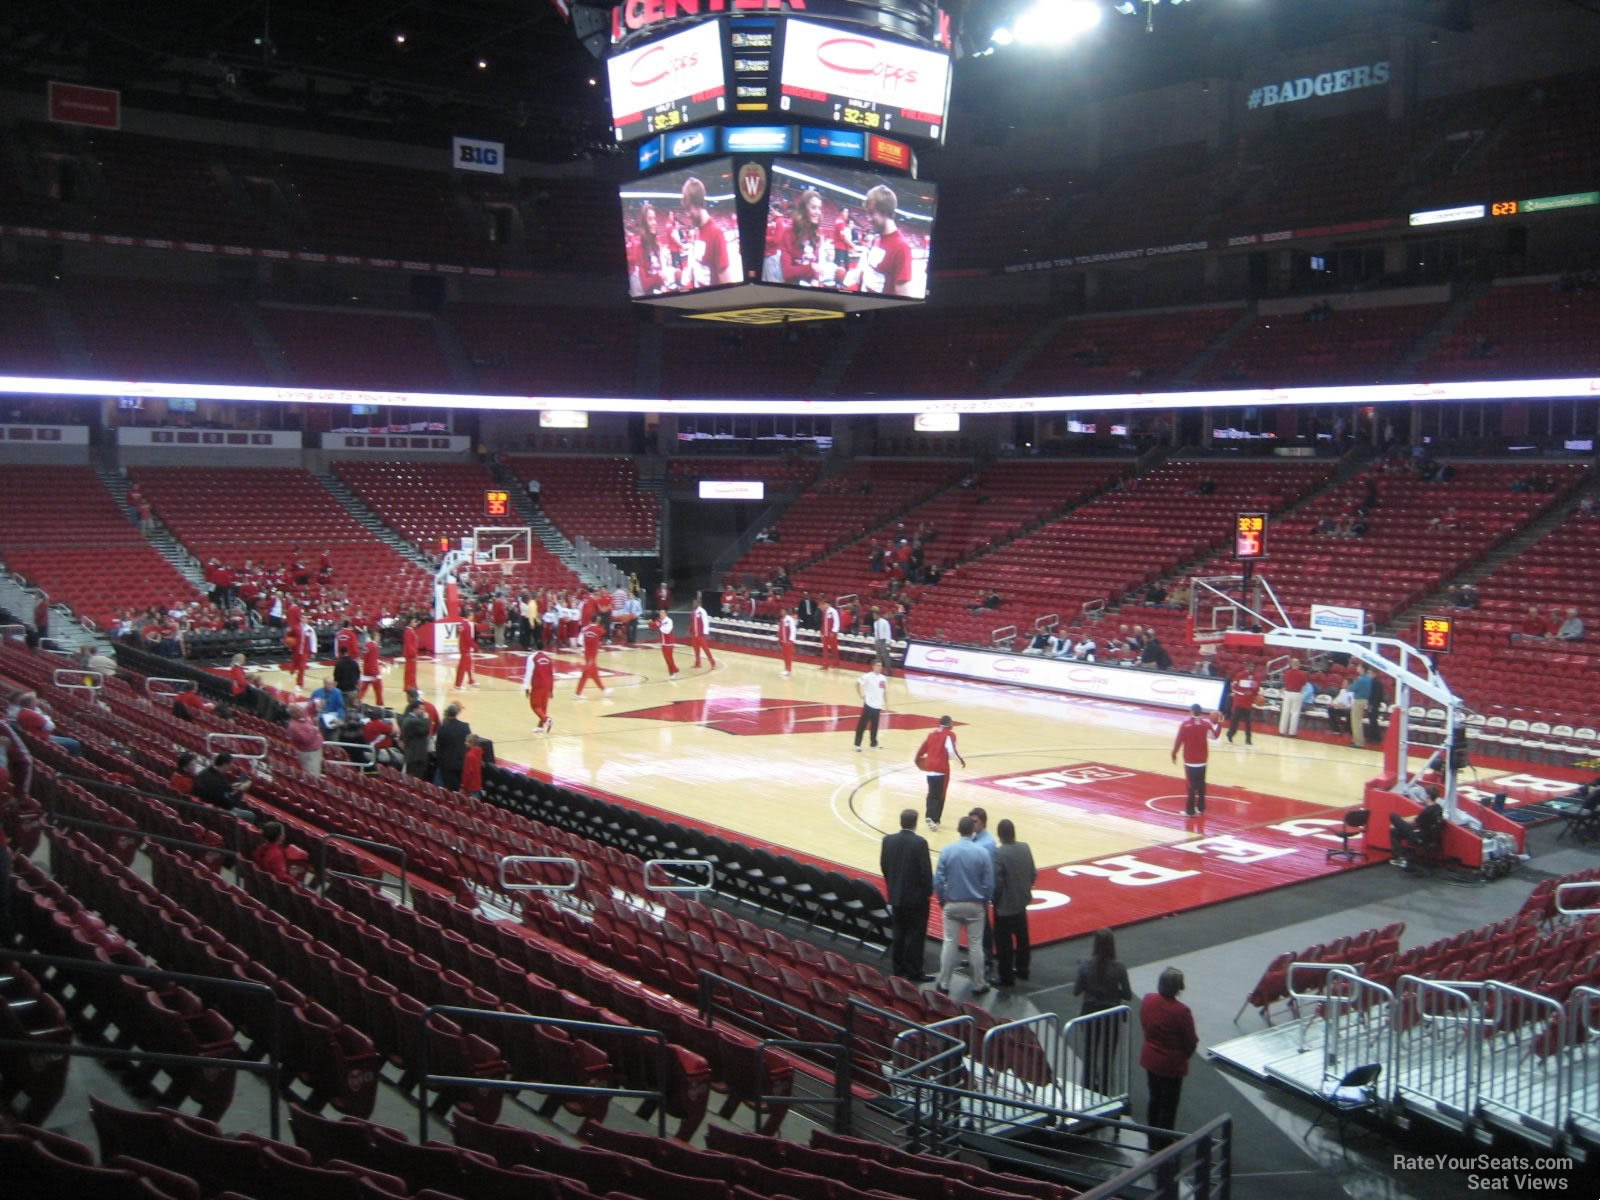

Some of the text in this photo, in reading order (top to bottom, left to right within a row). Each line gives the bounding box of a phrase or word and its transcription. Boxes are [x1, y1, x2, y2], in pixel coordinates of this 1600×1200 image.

[1247, 62, 1391, 109] #BADGERS
[745, 176, 761, 196] W
[1426, 631, 1445, 647] 35
